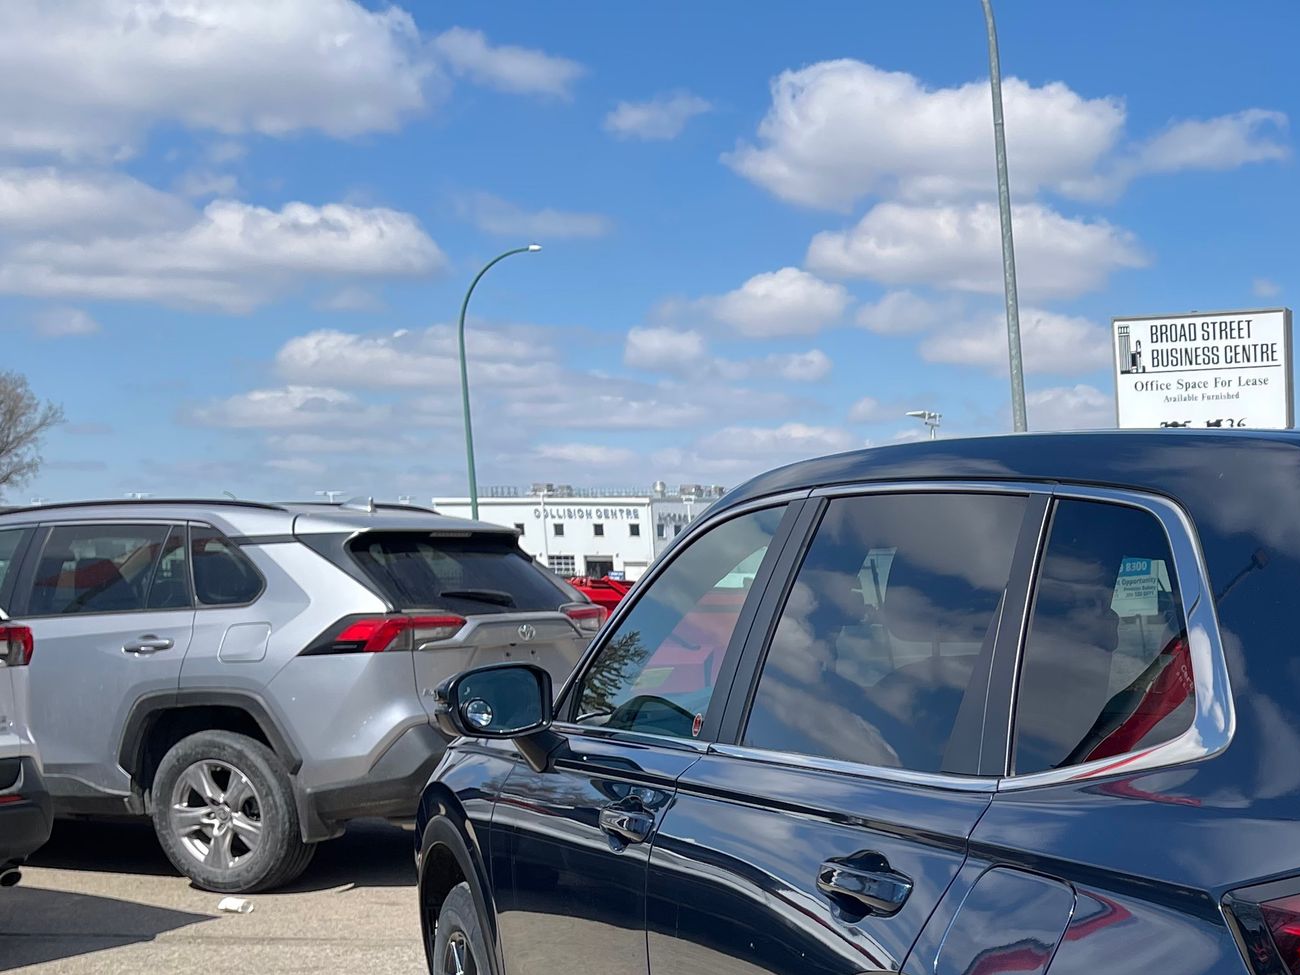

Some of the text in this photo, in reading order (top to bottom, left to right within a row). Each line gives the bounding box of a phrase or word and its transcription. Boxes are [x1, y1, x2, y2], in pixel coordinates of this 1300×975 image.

[1150, 320, 1253, 344] BROAD STREET
[1151, 343, 1278, 368] BUSINESS CENTRE
[1134, 375, 1270, 392] Office Space For Lease
[1163, 391, 1240, 403] Available Furnished
[533, 508, 640, 519] COLLISION CENTRE
